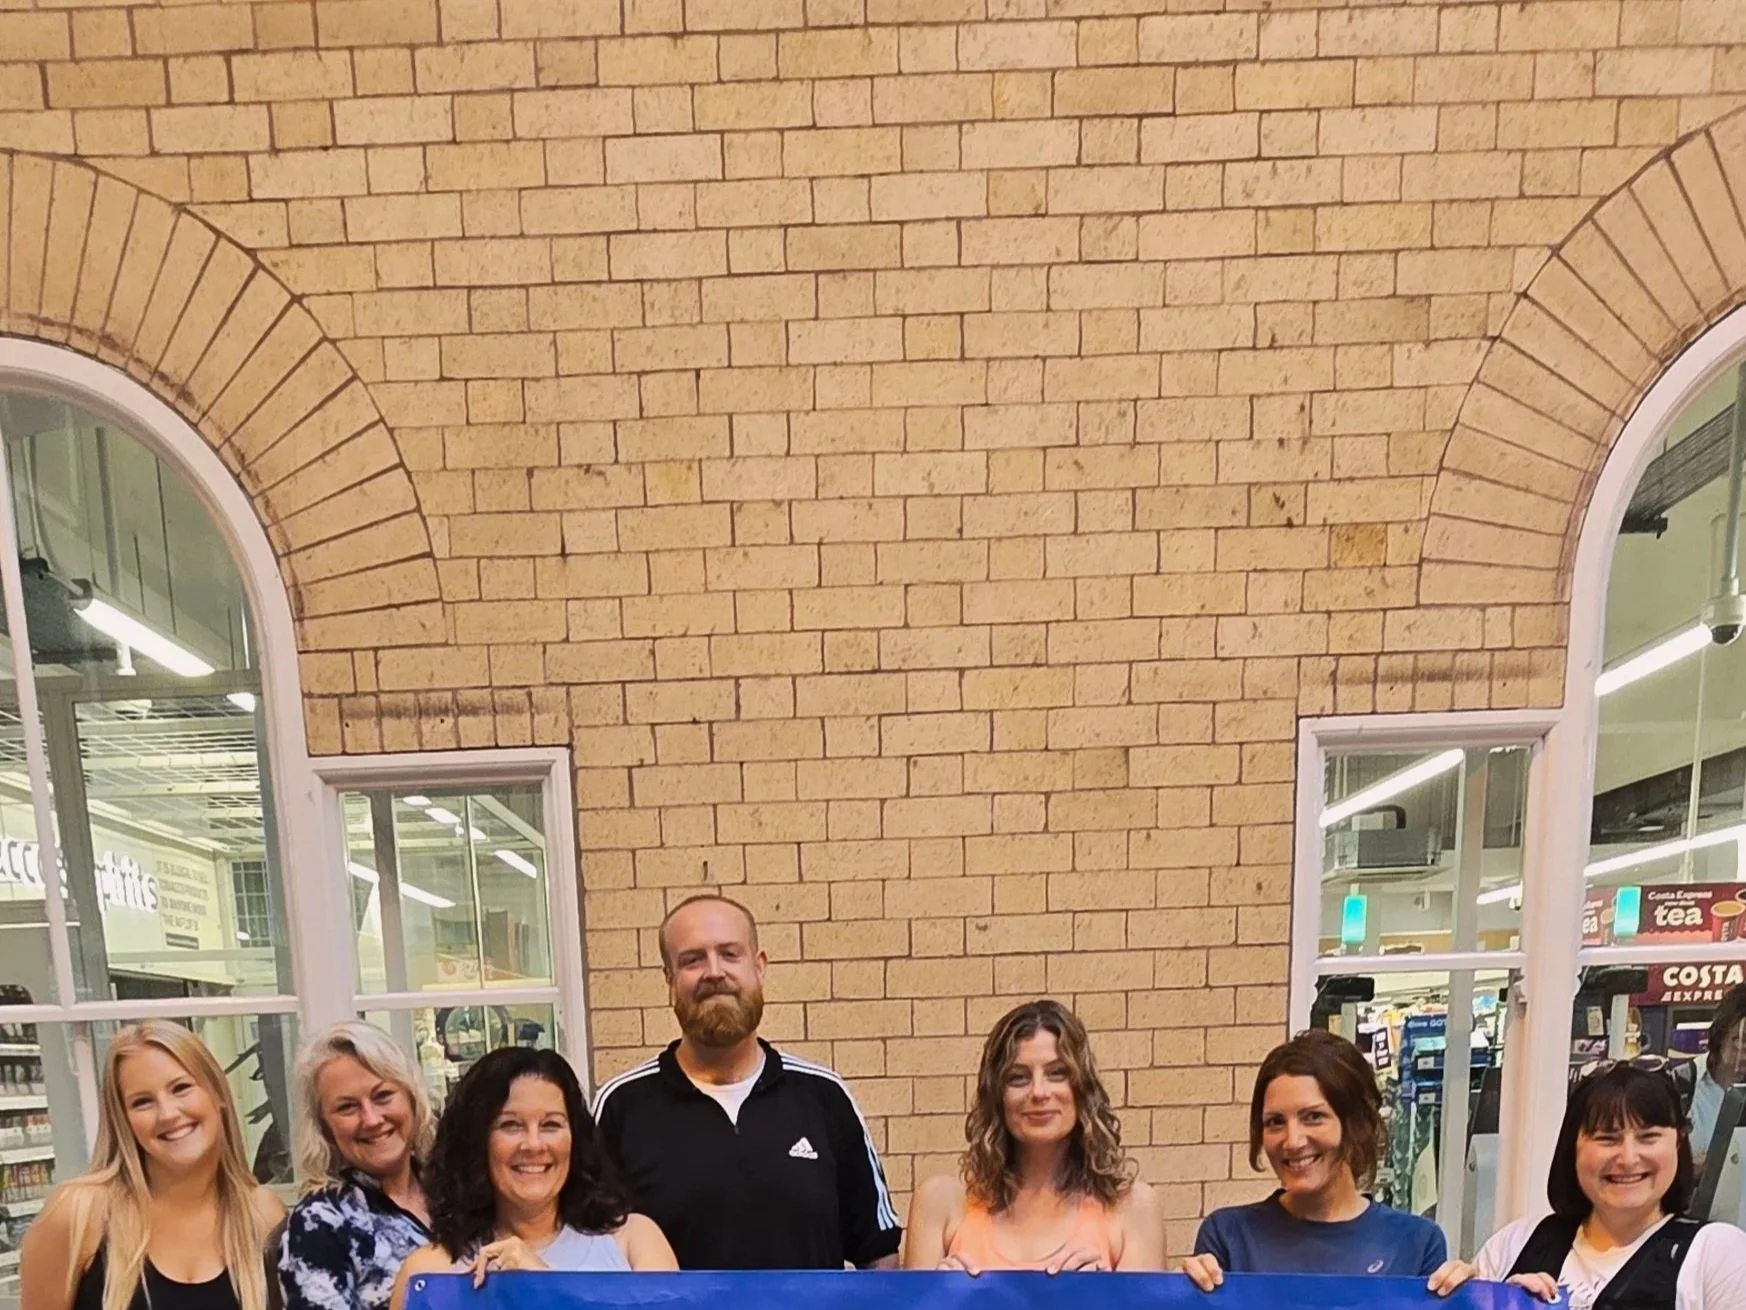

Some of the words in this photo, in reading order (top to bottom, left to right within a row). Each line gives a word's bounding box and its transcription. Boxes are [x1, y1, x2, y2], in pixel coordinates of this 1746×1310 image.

[1583, 915, 1598, 933] ea
[1654, 905, 1704, 926] tea
[1663, 964, 1744, 988] COSTA
[1673, 989, 1723, 1002] EXPRE
